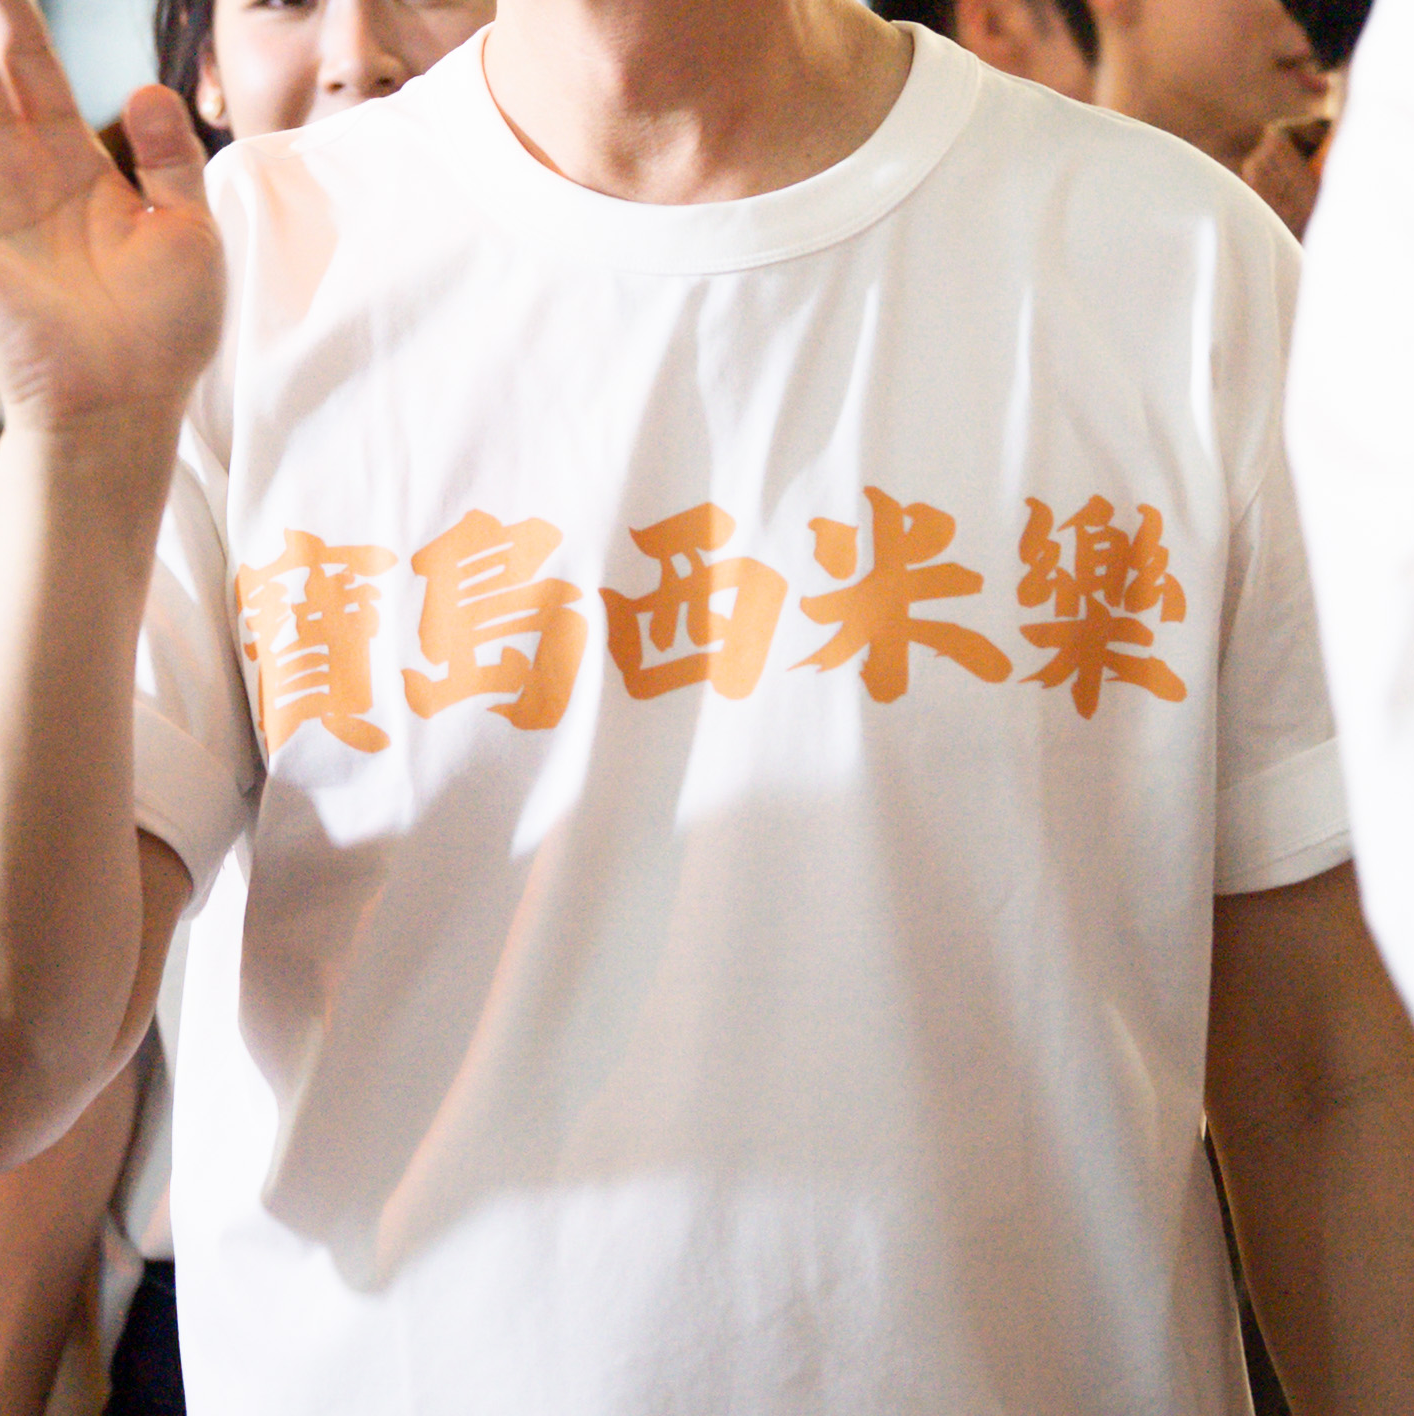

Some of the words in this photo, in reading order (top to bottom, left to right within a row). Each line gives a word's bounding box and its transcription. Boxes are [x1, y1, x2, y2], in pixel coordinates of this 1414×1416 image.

[235, 486, 1187, 762] 寶島西米樂
